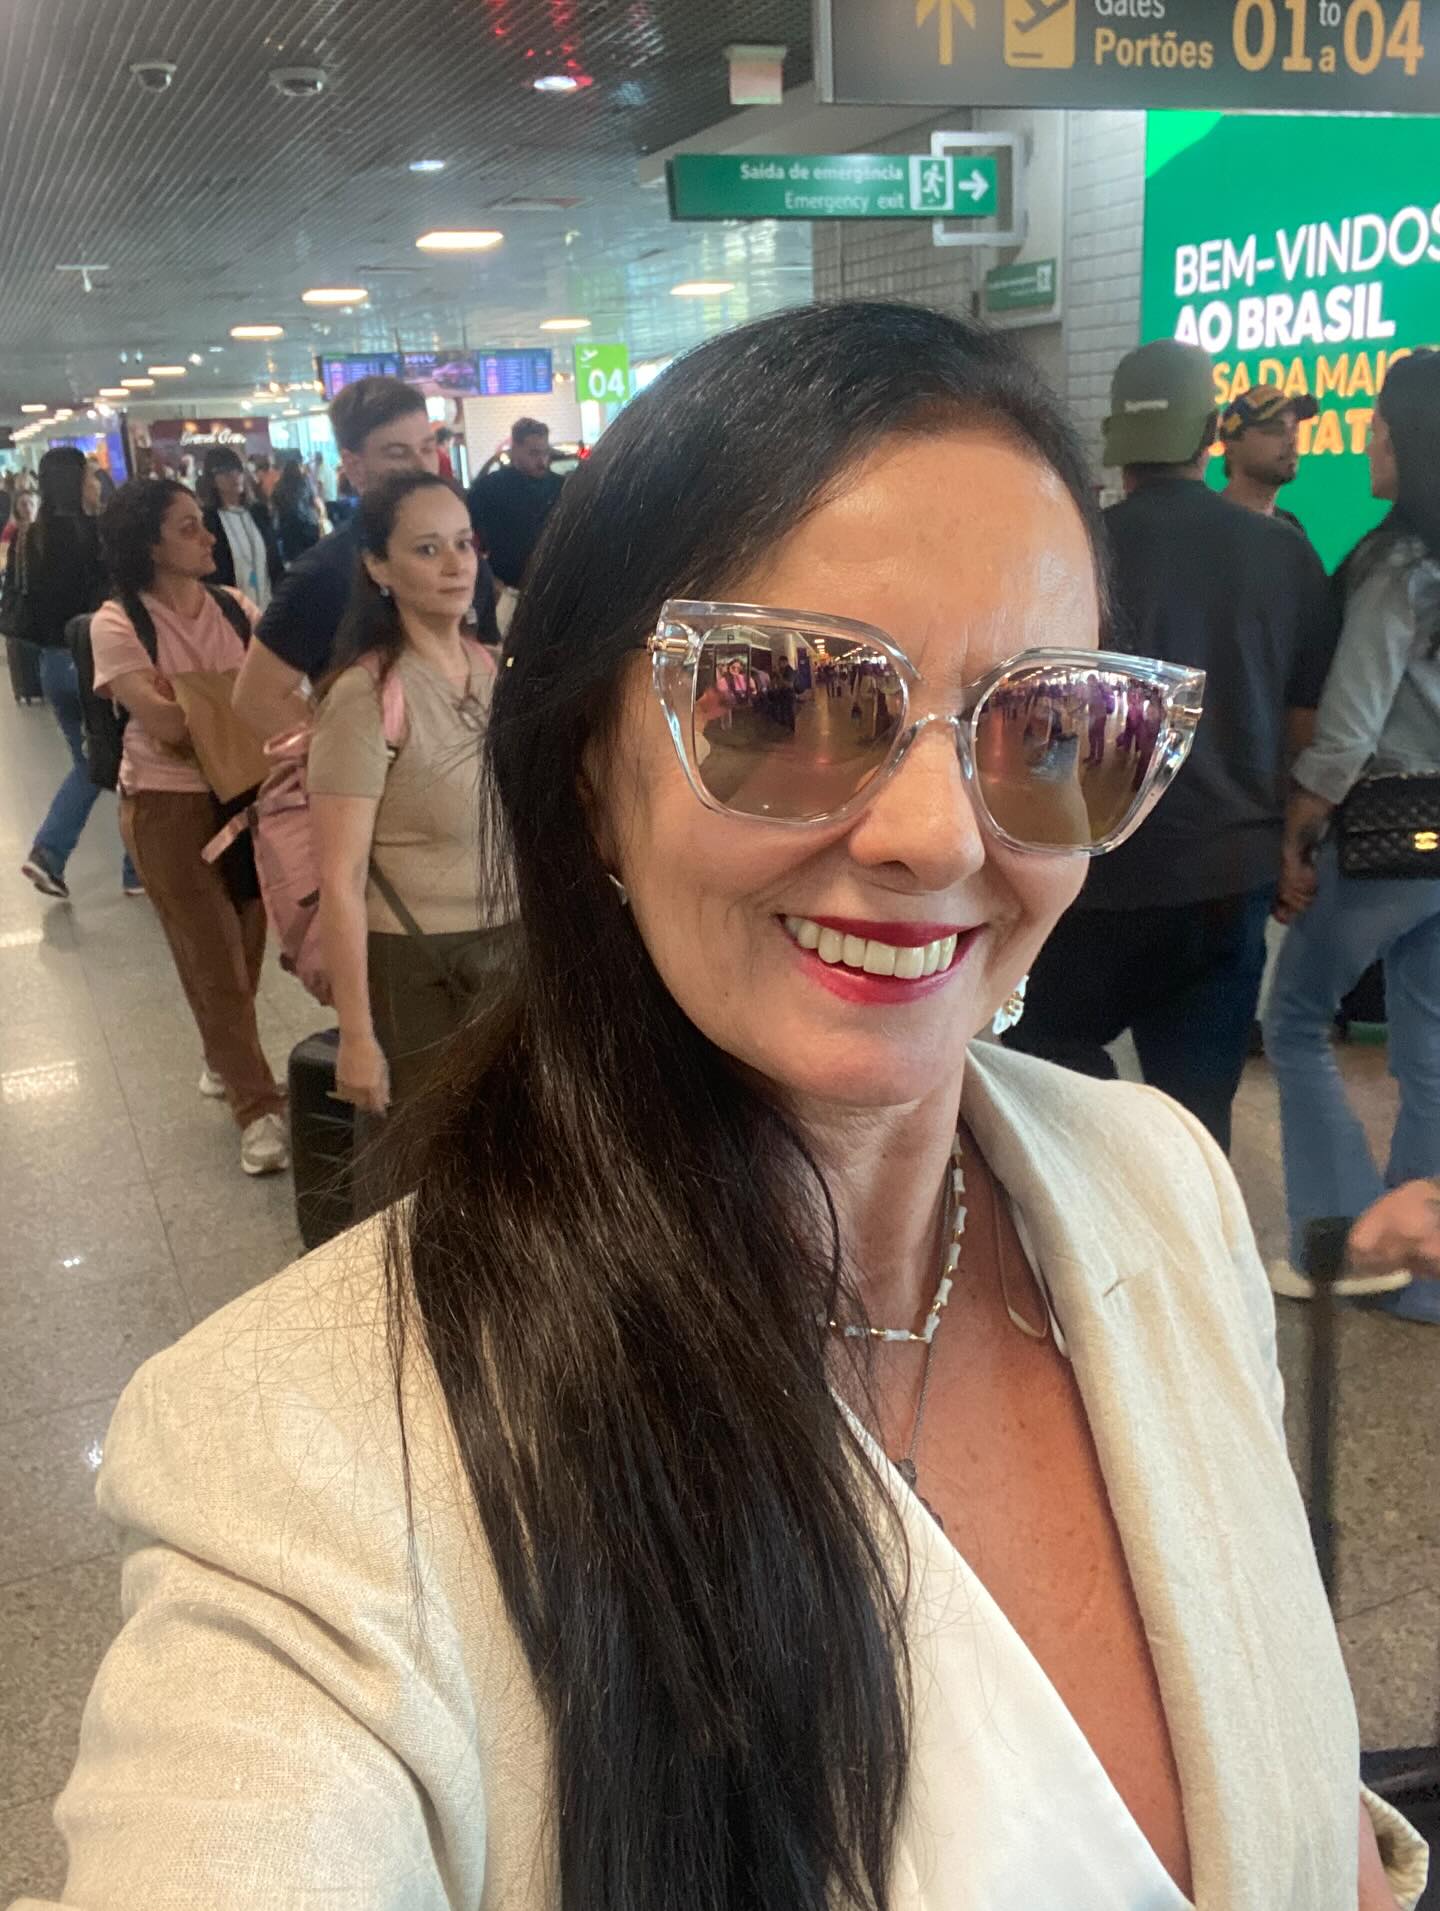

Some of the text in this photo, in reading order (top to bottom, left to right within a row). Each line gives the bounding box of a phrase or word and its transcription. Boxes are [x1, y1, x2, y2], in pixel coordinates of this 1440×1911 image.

[1095, 28, 1213, 69] Portões
[1232, 0, 1312, 72] 01
[1344, 0, 1424, 76] 04
[1319, 46, 1336, 73] a
[788, 164, 810, 180] de
[784, 190, 905, 213] Emergency exit
[1174, 281, 1396, 354] AO BRASIL
[588, 368, 626, 398] 04
[1315, 347, 1413, 399] MAI
